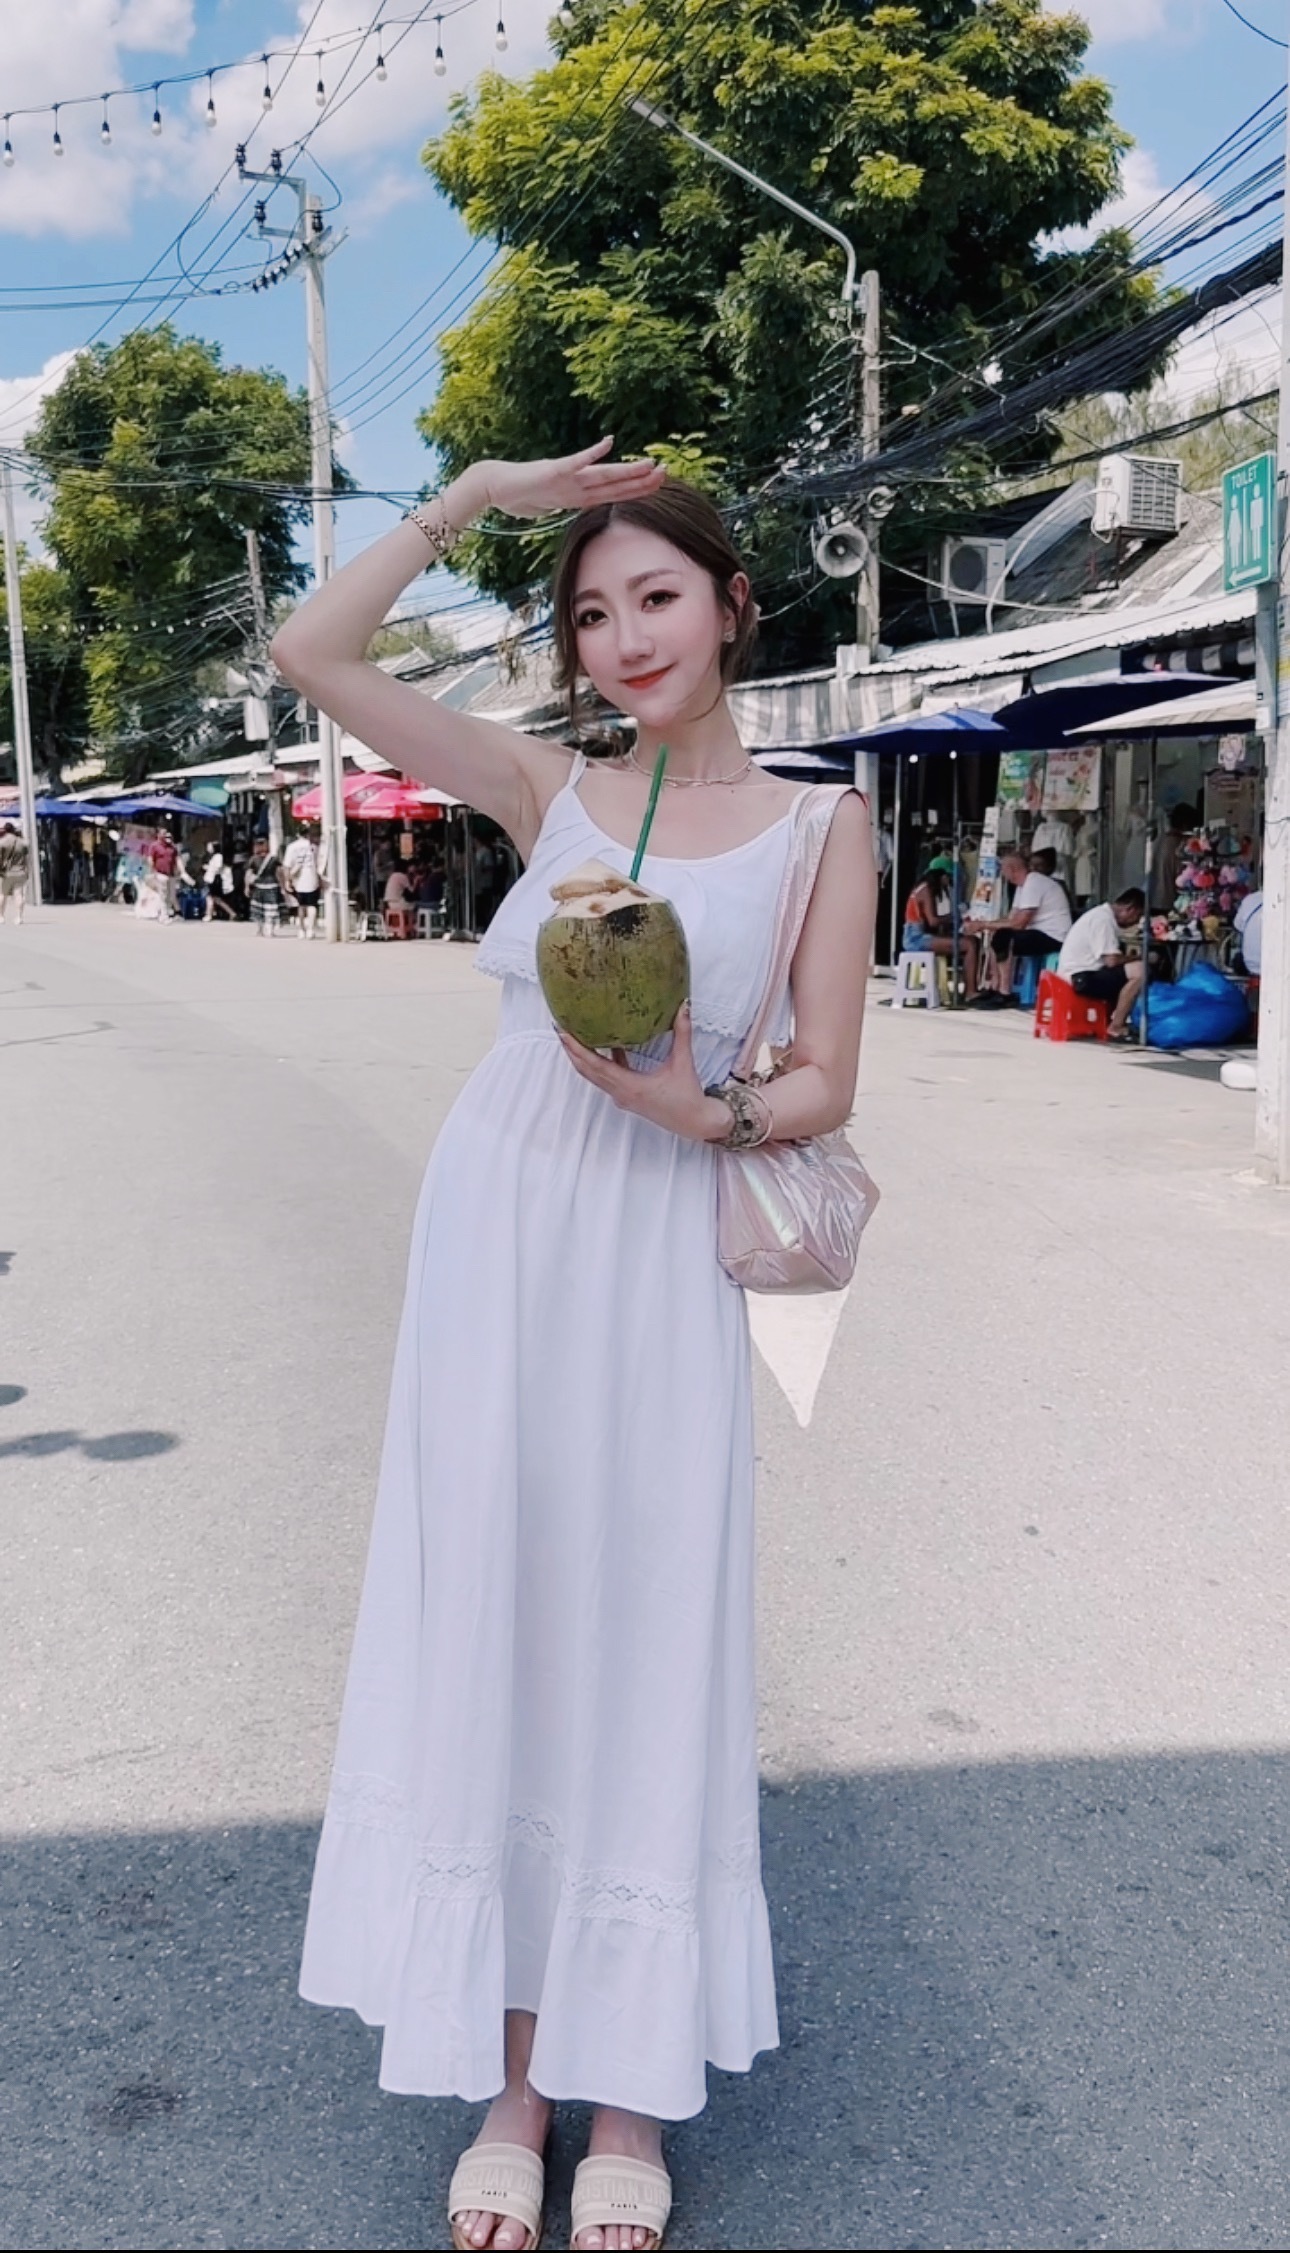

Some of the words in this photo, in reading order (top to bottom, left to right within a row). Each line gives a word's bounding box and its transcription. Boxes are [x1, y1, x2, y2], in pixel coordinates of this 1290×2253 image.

[1231, 464, 1258, 490] TOILET
[480, 2188, 509, 2199] PARIS
[610, 2201, 639, 2211] PARIS
